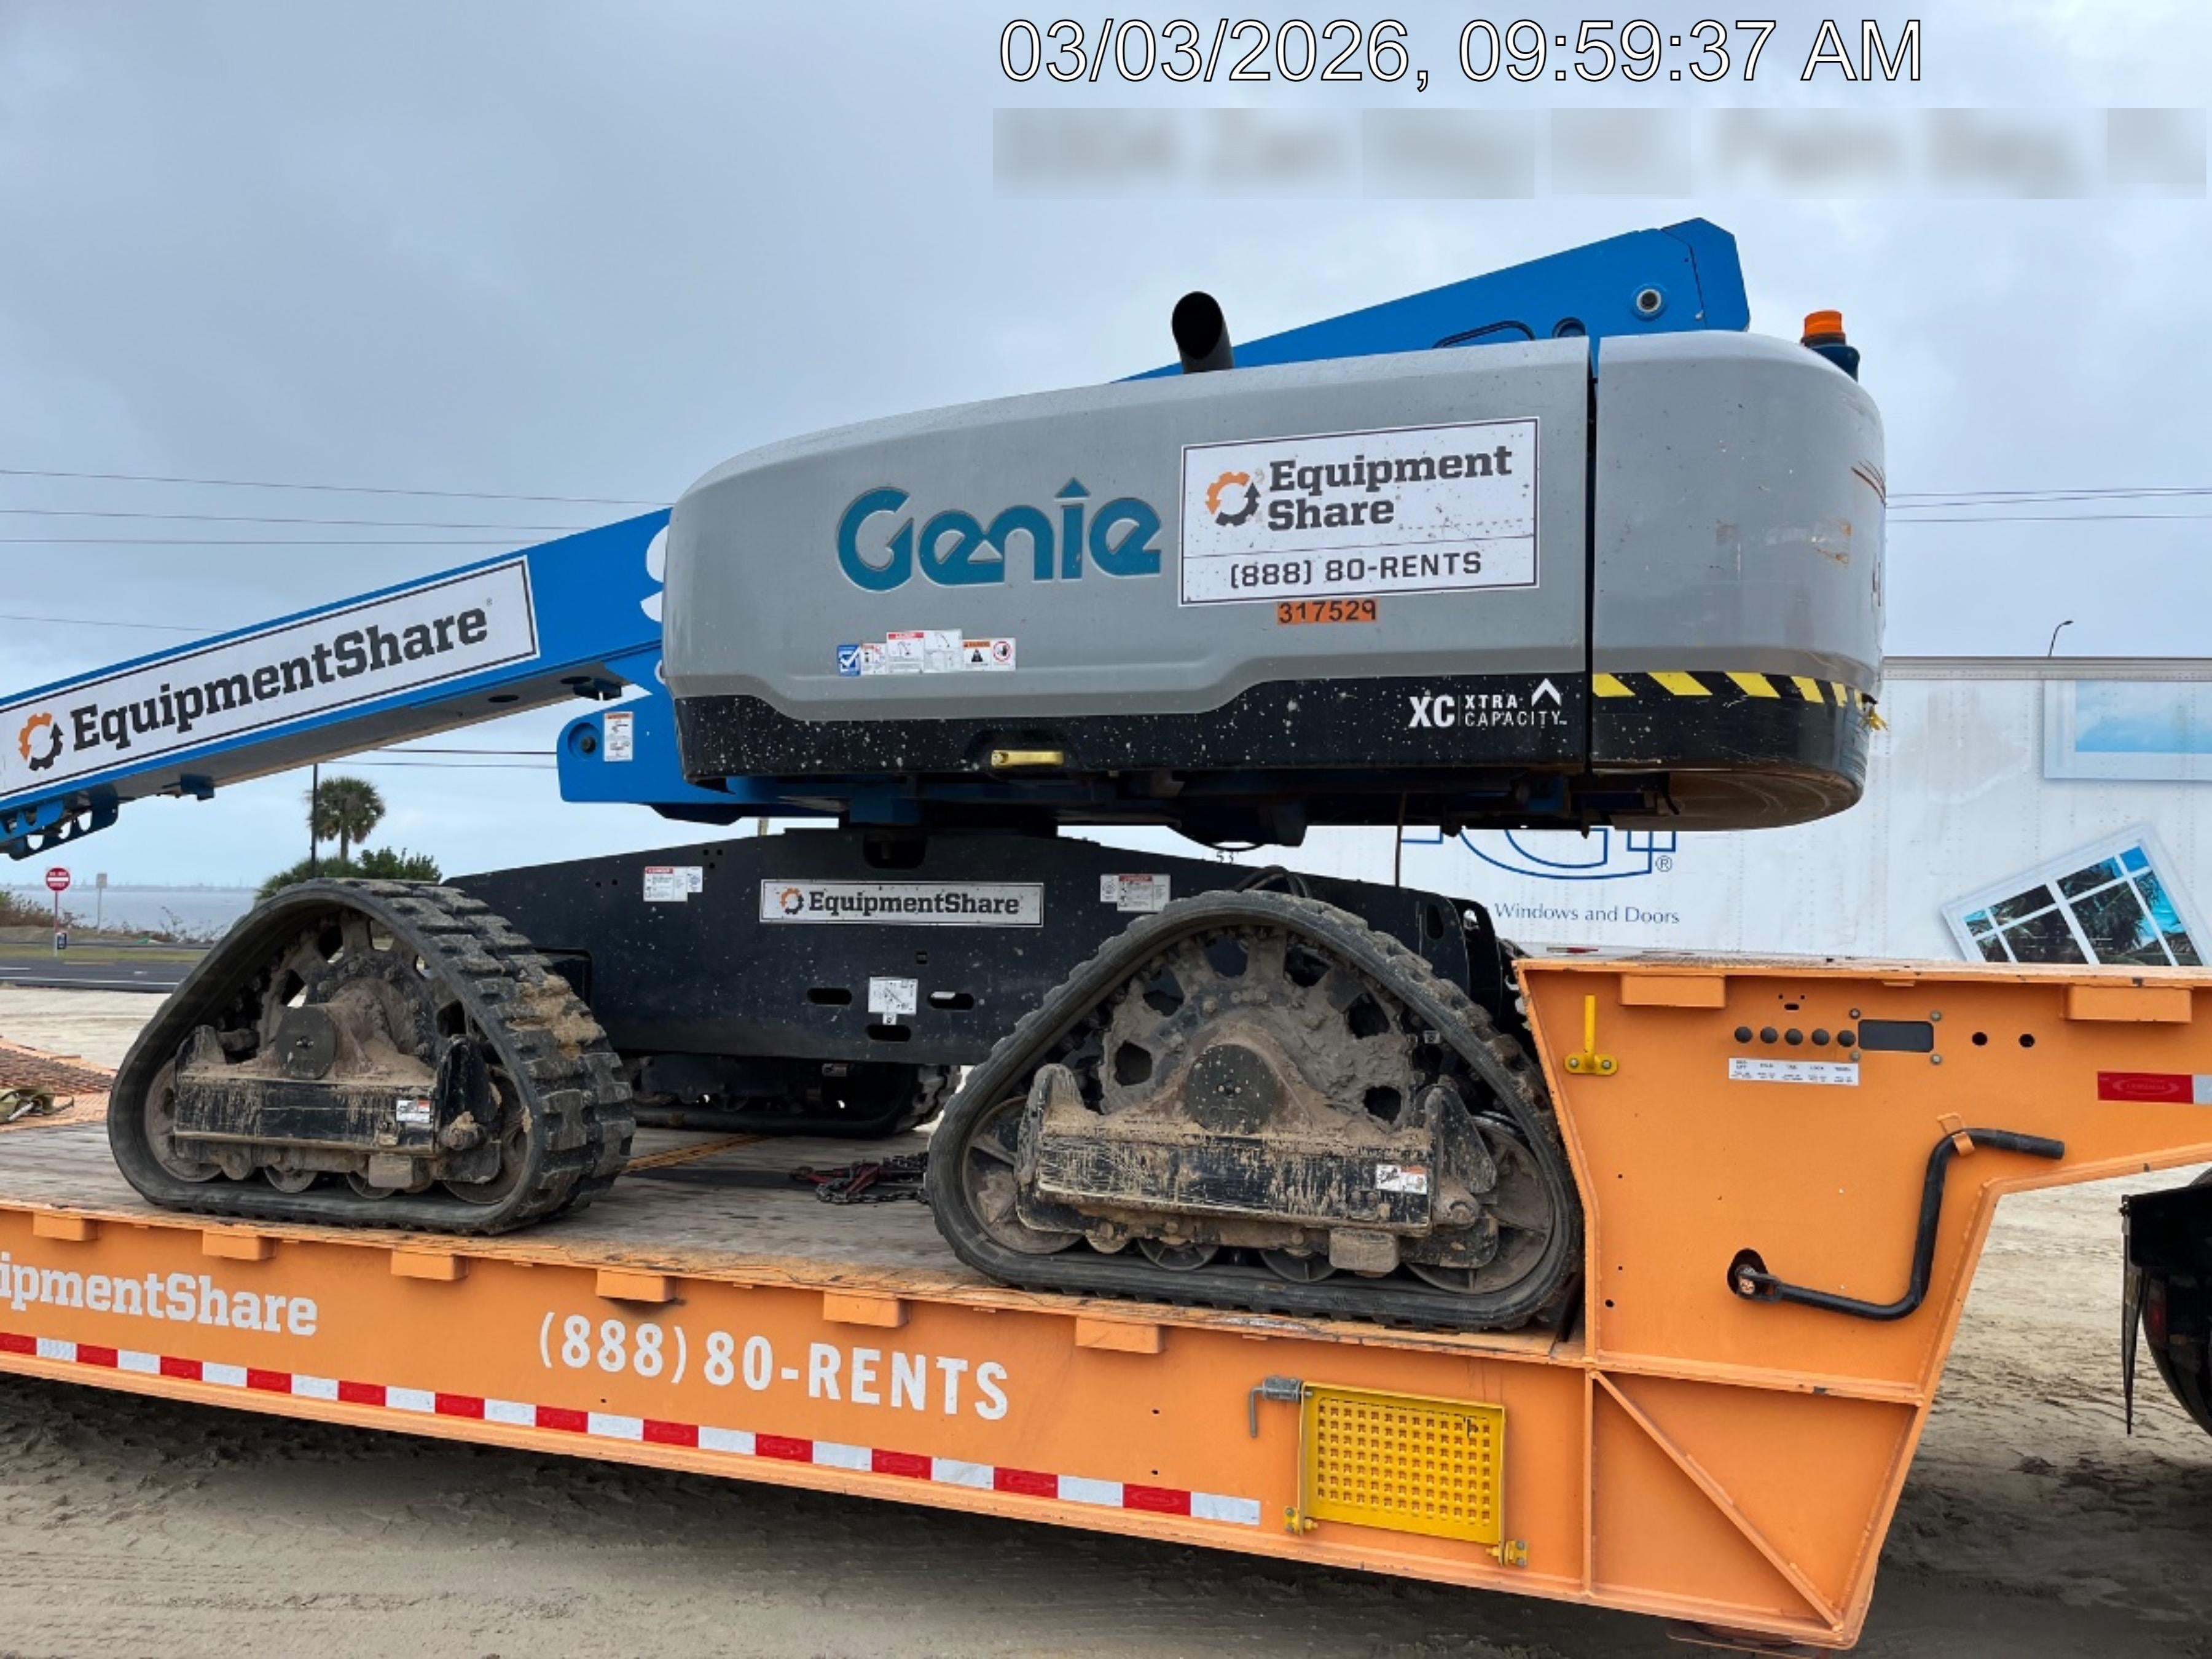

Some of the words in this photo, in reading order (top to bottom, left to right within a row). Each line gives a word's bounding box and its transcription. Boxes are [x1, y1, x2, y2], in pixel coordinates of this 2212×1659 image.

[1269, 445, 1513, 496] Equipment
[1268, 500, 1395, 531] Share
[836, 477, 1162, 592] Genie
[1231, 560, 1312, 589] (888)
[1325, 551, 1481, 581] 80-RENTS
[1279, 598, 1377, 624] 317529
[69, 608, 487, 752] EquipmentShare
[1408, 694, 1456, 728] XC
[1465, 694, 1518, 709] XTRA
[1465, 711, 1561, 726] CAPACITY
[809, 891, 1020, 917] EquipmentShare
[1494, 903, 1579, 920] Windows
[1584, 906, 1618, 922] and
[1625, 906, 1681, 924] Doors
[541, 1312, 687, 1383] (888)
[704, 1331, 1008, 1420] 80-RENTS
